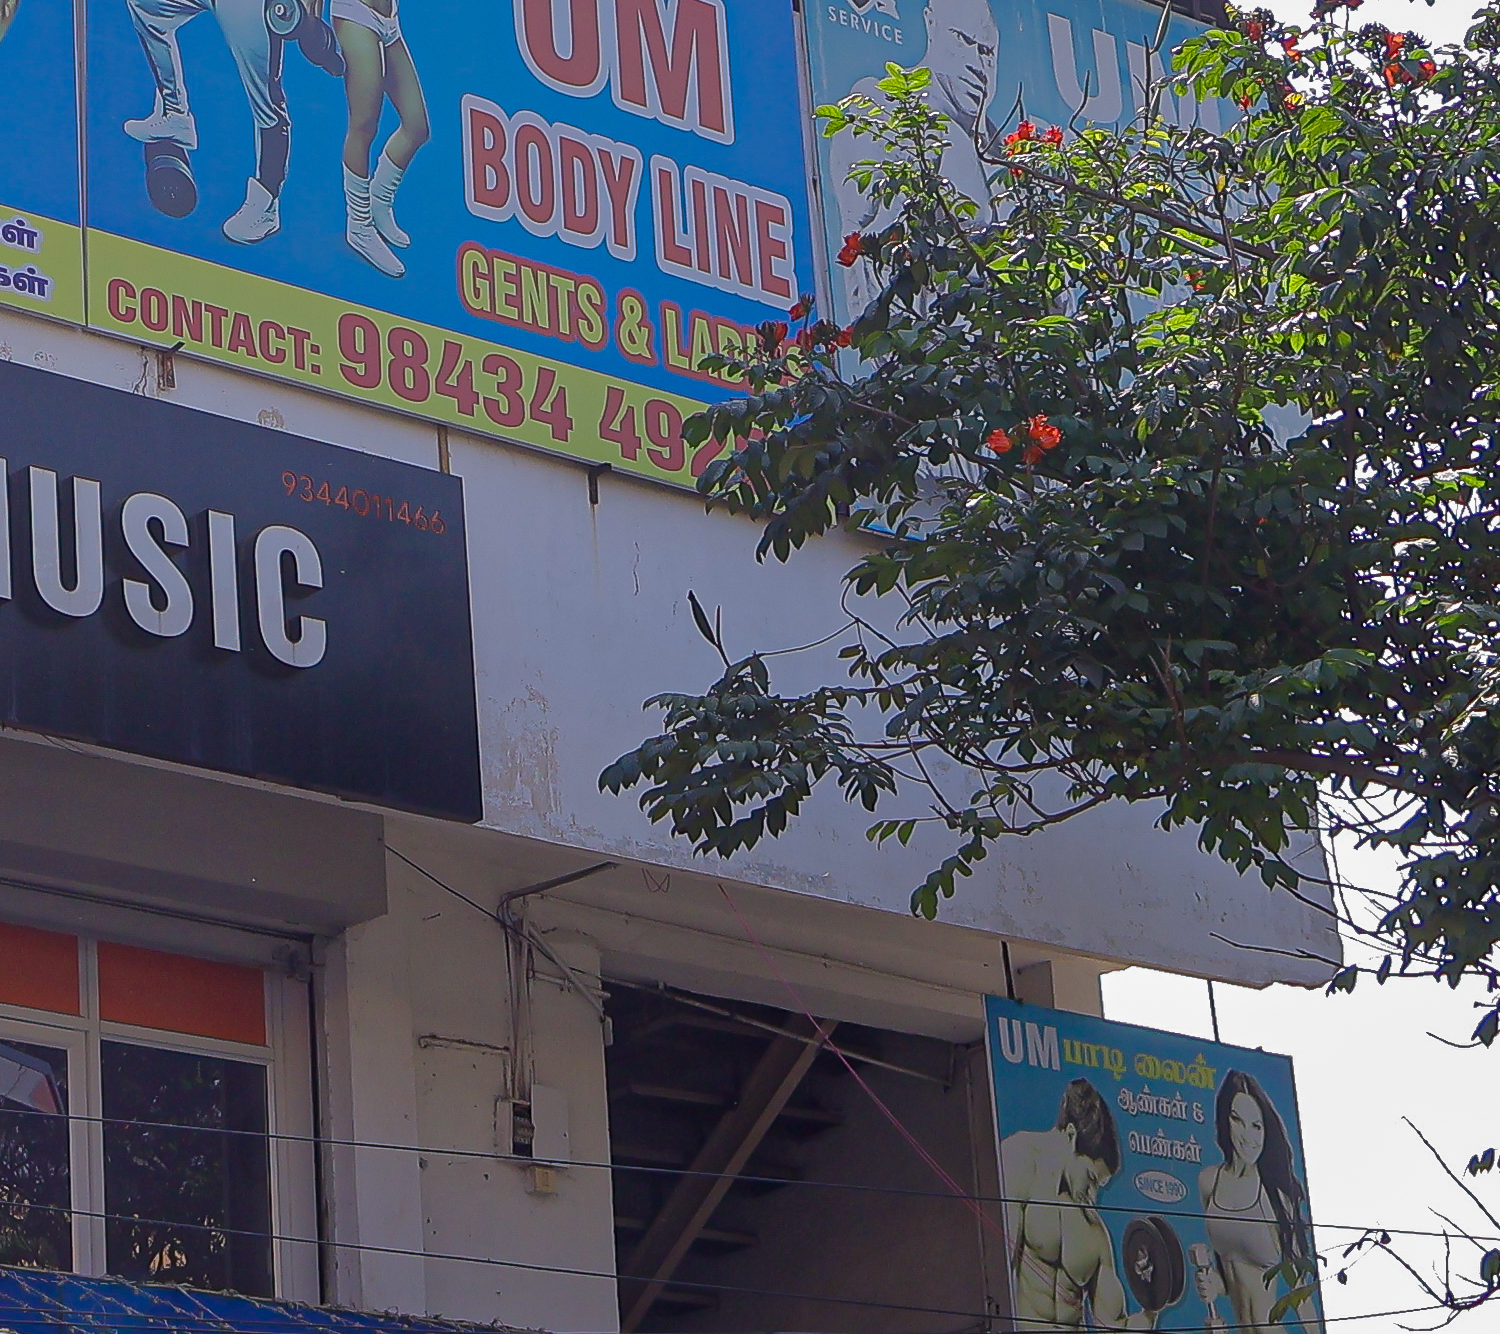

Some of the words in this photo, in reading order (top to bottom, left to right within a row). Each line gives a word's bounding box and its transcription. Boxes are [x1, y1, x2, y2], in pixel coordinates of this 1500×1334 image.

[828, 4, 905, 46] SERVICE
[465, 99, 642, 255] BODY
[654, 163, 795, 303] LINE
[459, 244, 606, 349] GENTS
[617, 285, 655, 365] &
[107, 276, 324, 376] CONTACT:
[338, 312, 575, 444] 98434
[280, 468, 448, 535] 9344011466
[997, 1016, 1062, 1072] UM
